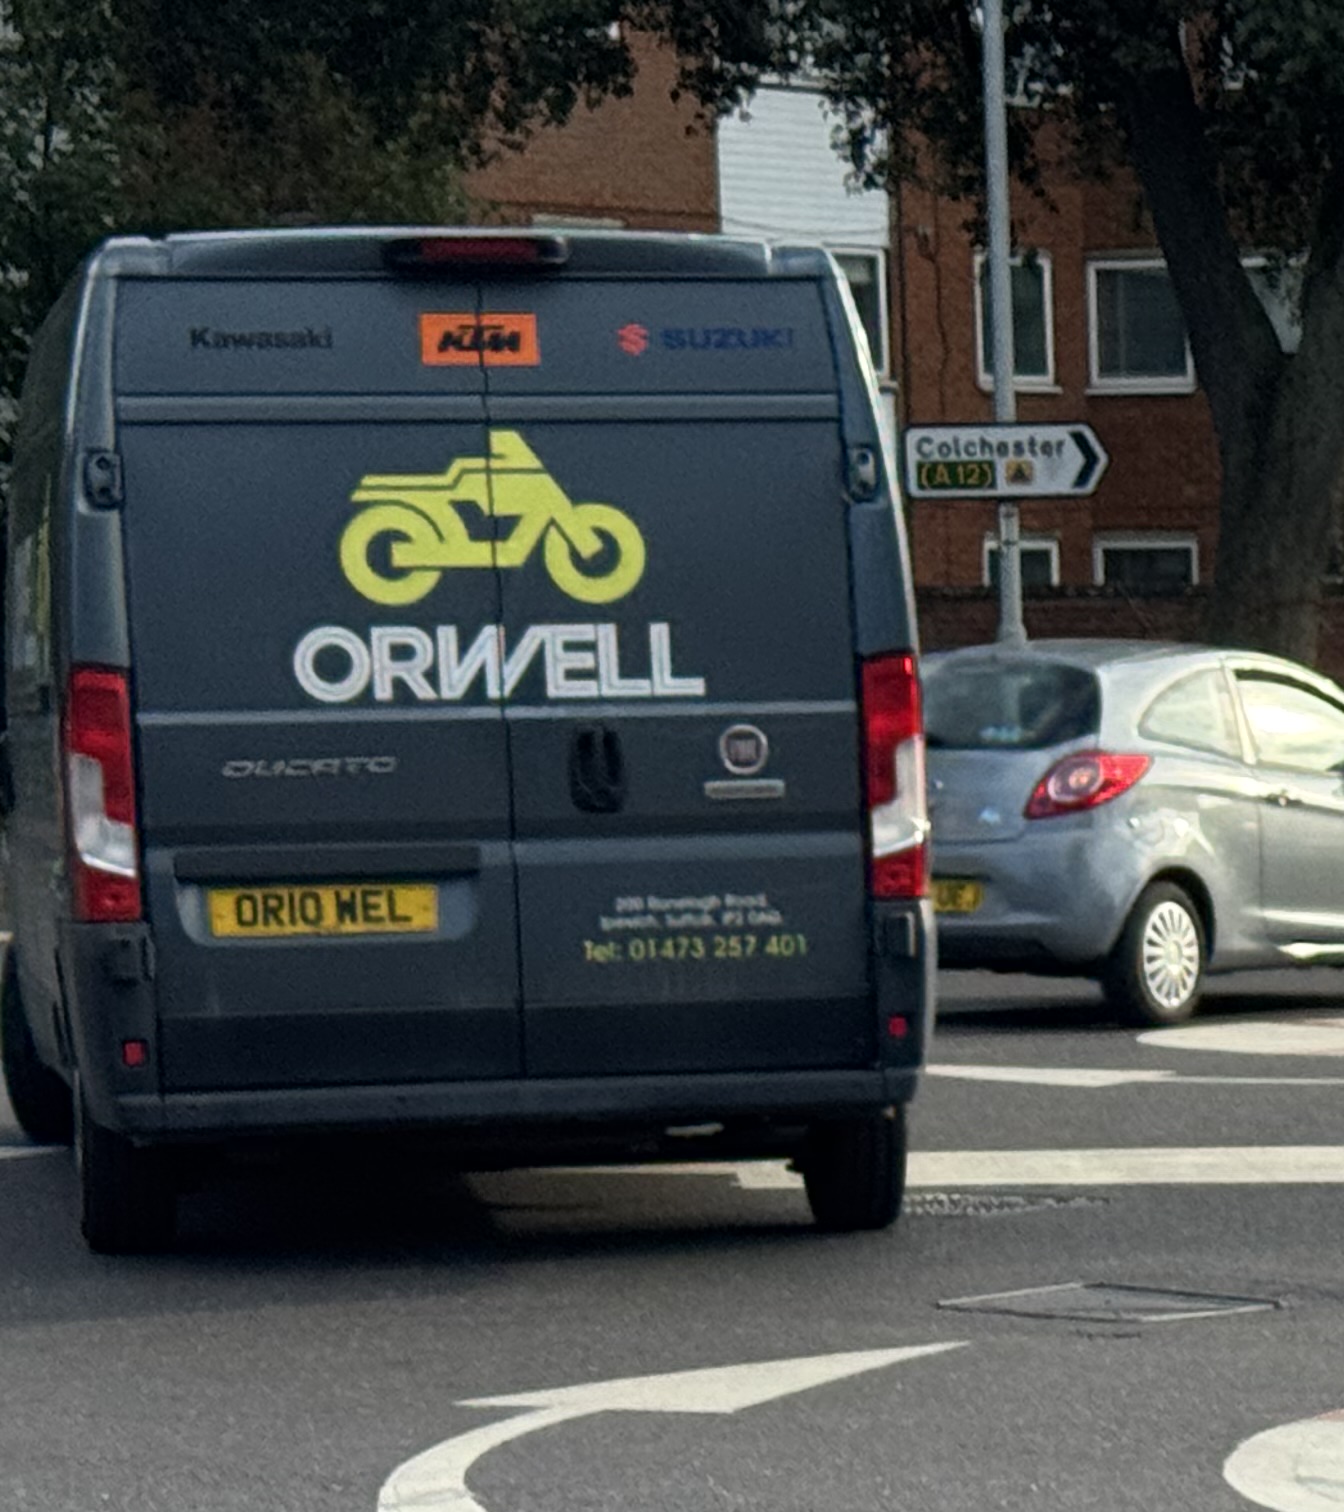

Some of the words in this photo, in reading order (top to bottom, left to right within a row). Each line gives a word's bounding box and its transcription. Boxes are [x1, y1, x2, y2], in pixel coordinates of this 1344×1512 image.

[190, 326, 333, 350] Kawasaki
[437, 324, 521, 353] KTM
[660, 327, 794, 350] SUZUKI
[915, 435, 1066, 459] Colchester
[293, 622, 707, 702] ORWELL
[584, 940, 624, 963] Tel:
[628, 938, 705, 961] 01473
[714, 935, 758, 958] 257
[765, 934, 808, 956] 401
